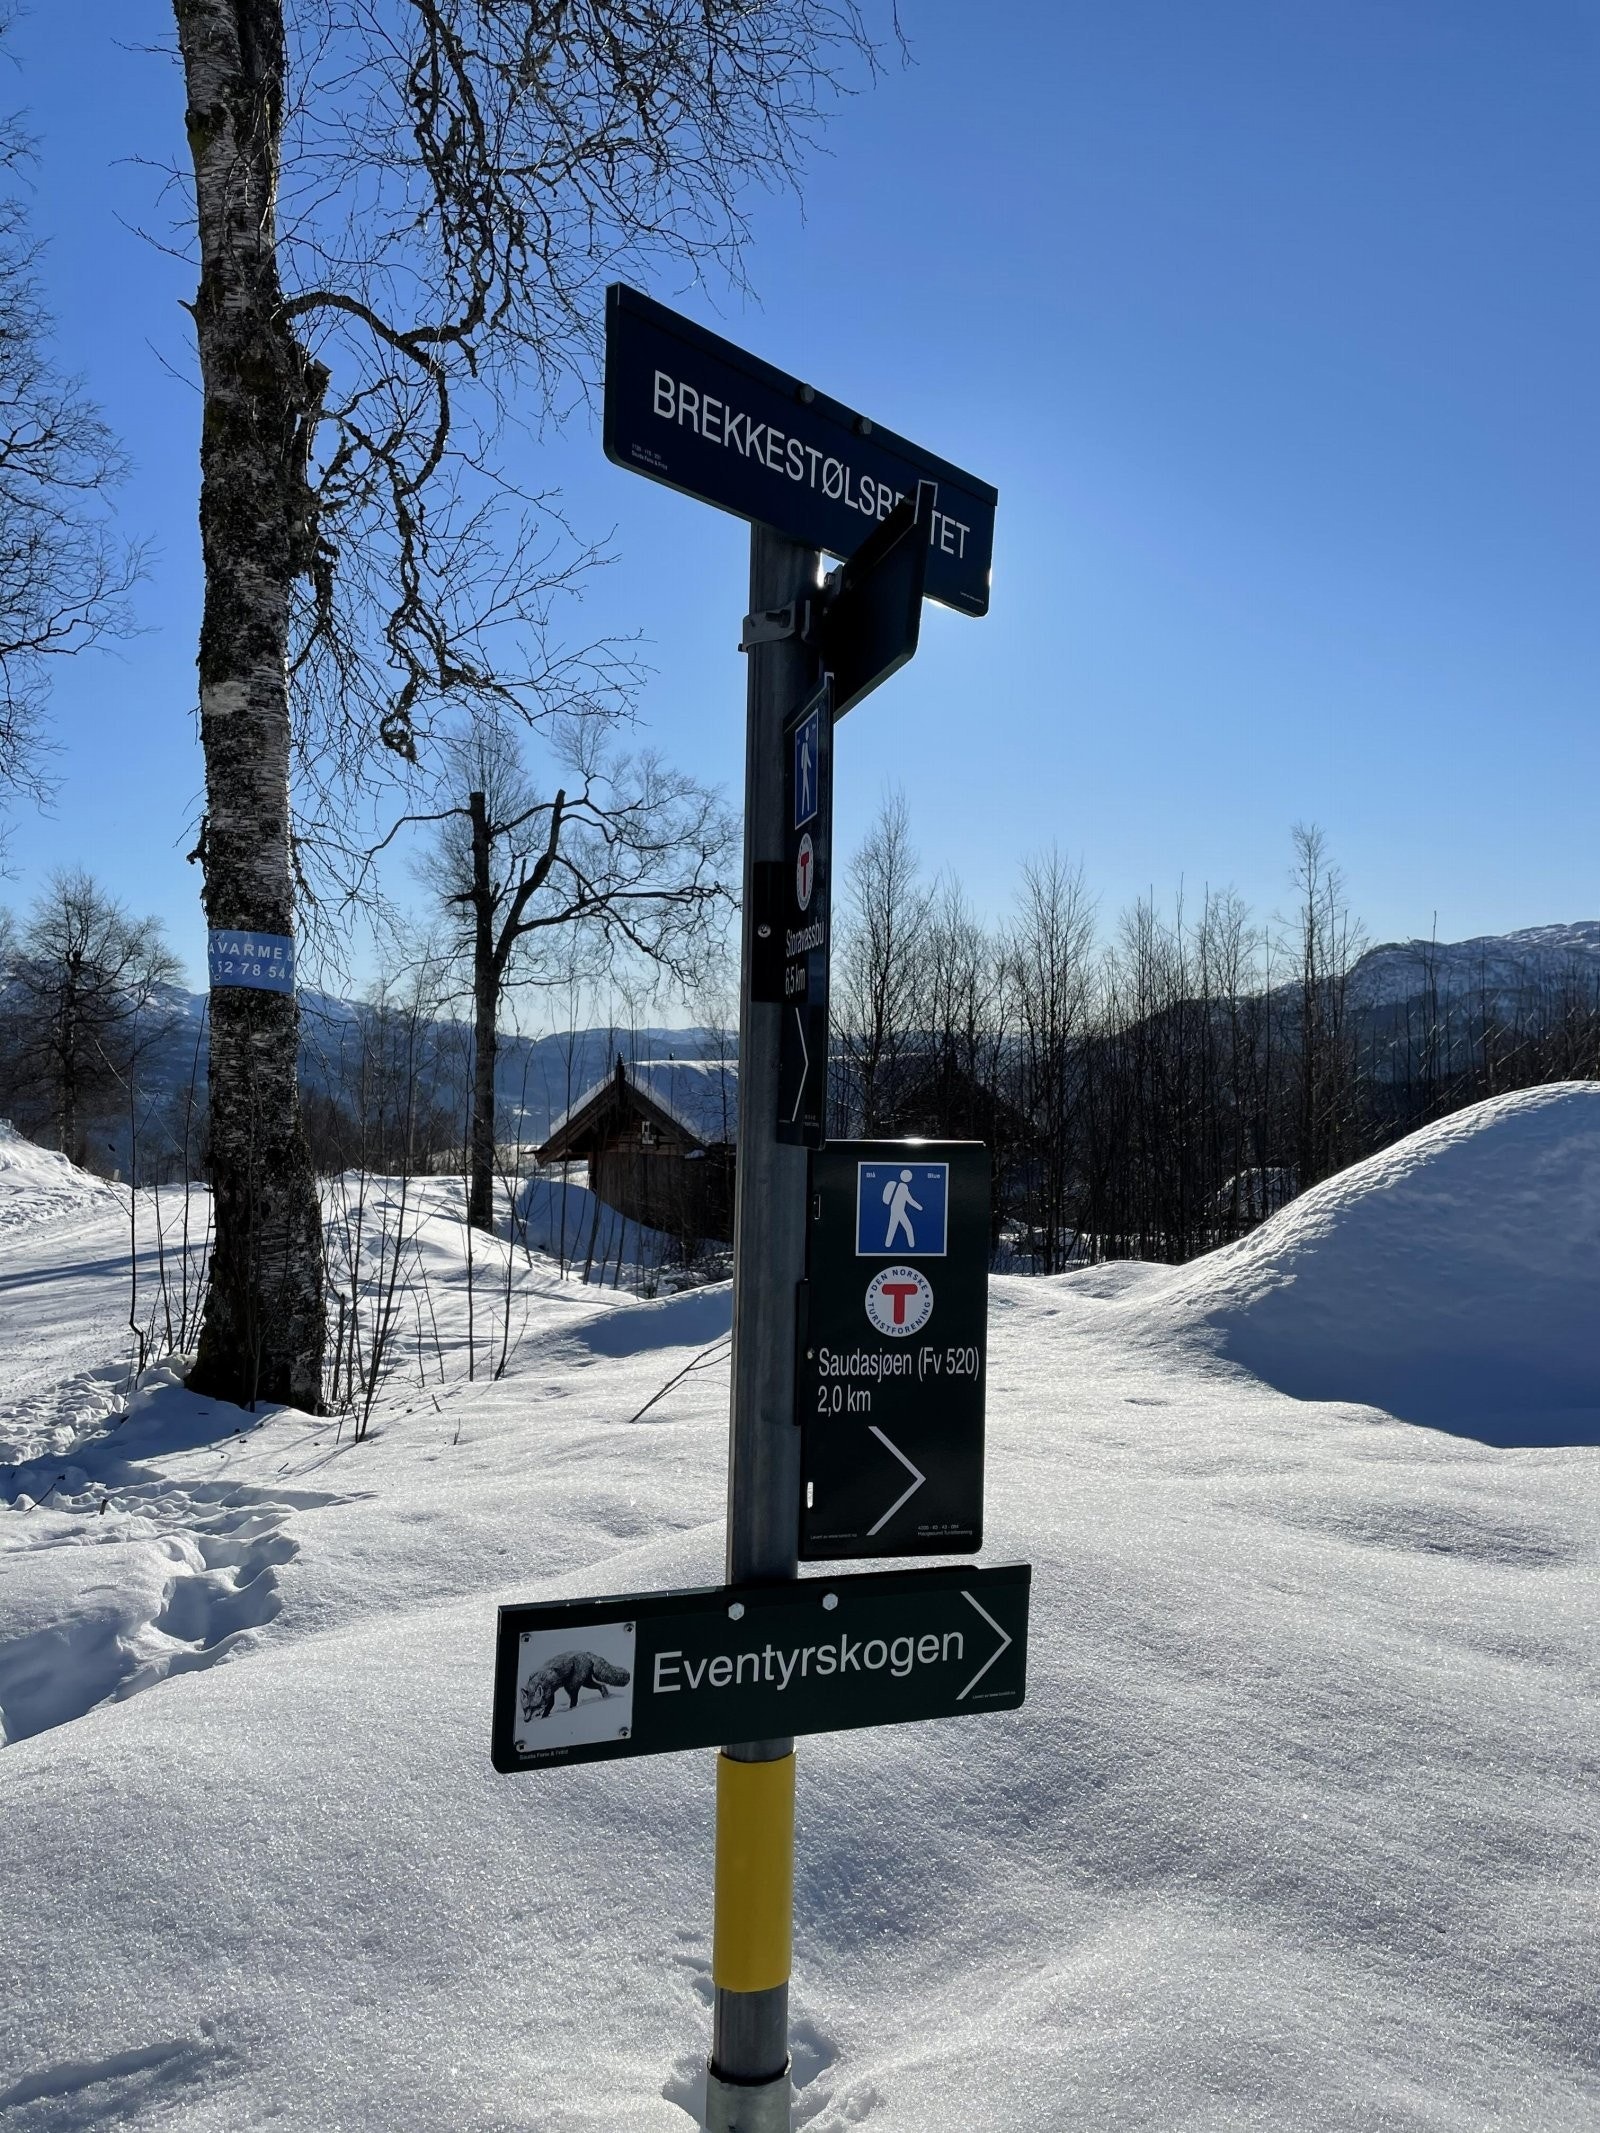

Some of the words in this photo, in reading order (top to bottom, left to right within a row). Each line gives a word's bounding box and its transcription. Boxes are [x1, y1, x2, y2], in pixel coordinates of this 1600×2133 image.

[653, 369, 971, 559] BREKKESTØLSBTET
[240, 962, 261, 976] 78
[268, 965, 285, 980] 54
[784, 966, 796, 999] 6,5
[795, 962, 806, 992] km
[871, 1273, 888, 1292] DEN
[892, 1268, 928, 1291] NORSKE
[867, 1301, 931, 1335] TURISTFORENING
[818, 1347, 912, 1383] Saudasjøen
[918, 1346, 942, 1382] (Fv
[946, 1346, 980, 1381] 520)
[817, 1384, 843, 1417] 2,0
[847, 1384, 871, 1412] km
[653, 1631, 964, 1694] Eventyrskogen
